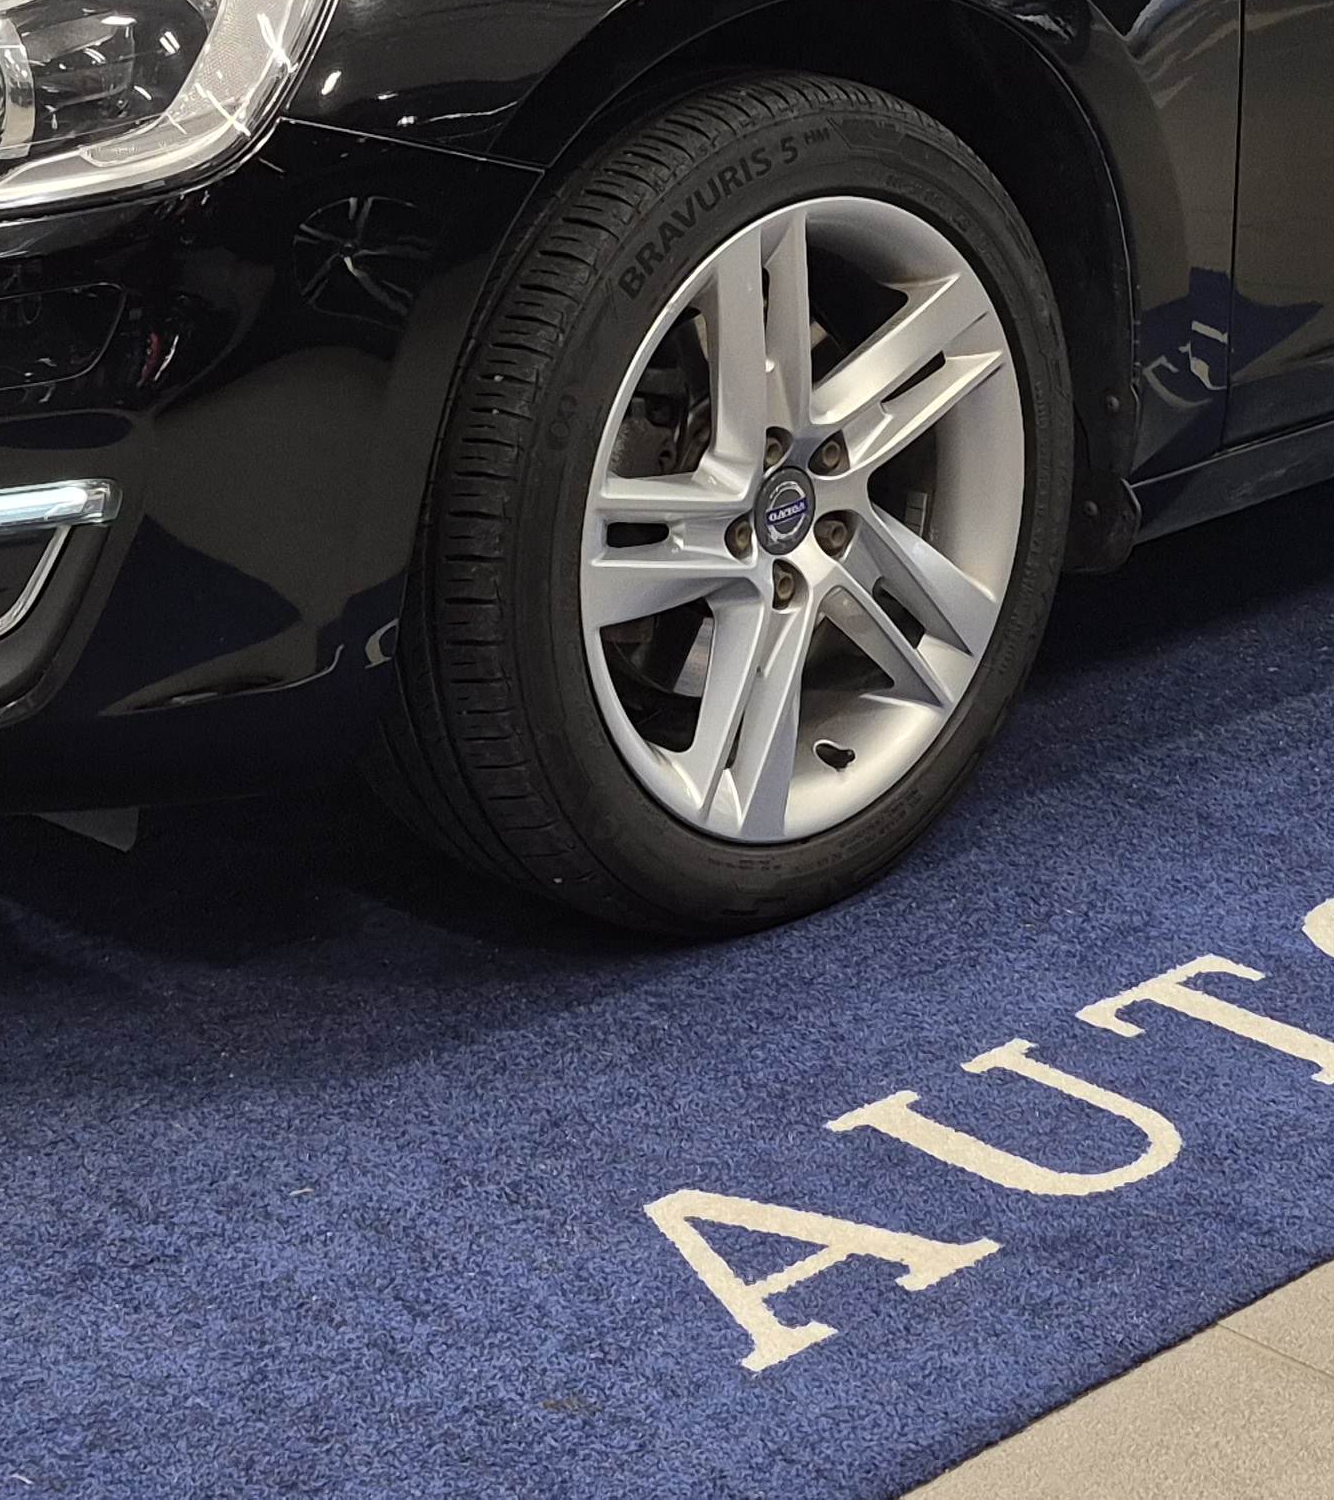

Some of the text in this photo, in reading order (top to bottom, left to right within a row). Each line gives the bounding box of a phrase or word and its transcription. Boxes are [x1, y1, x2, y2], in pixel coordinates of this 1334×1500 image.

[618, 126, 830, 300] BRAVURIS 5 HM
